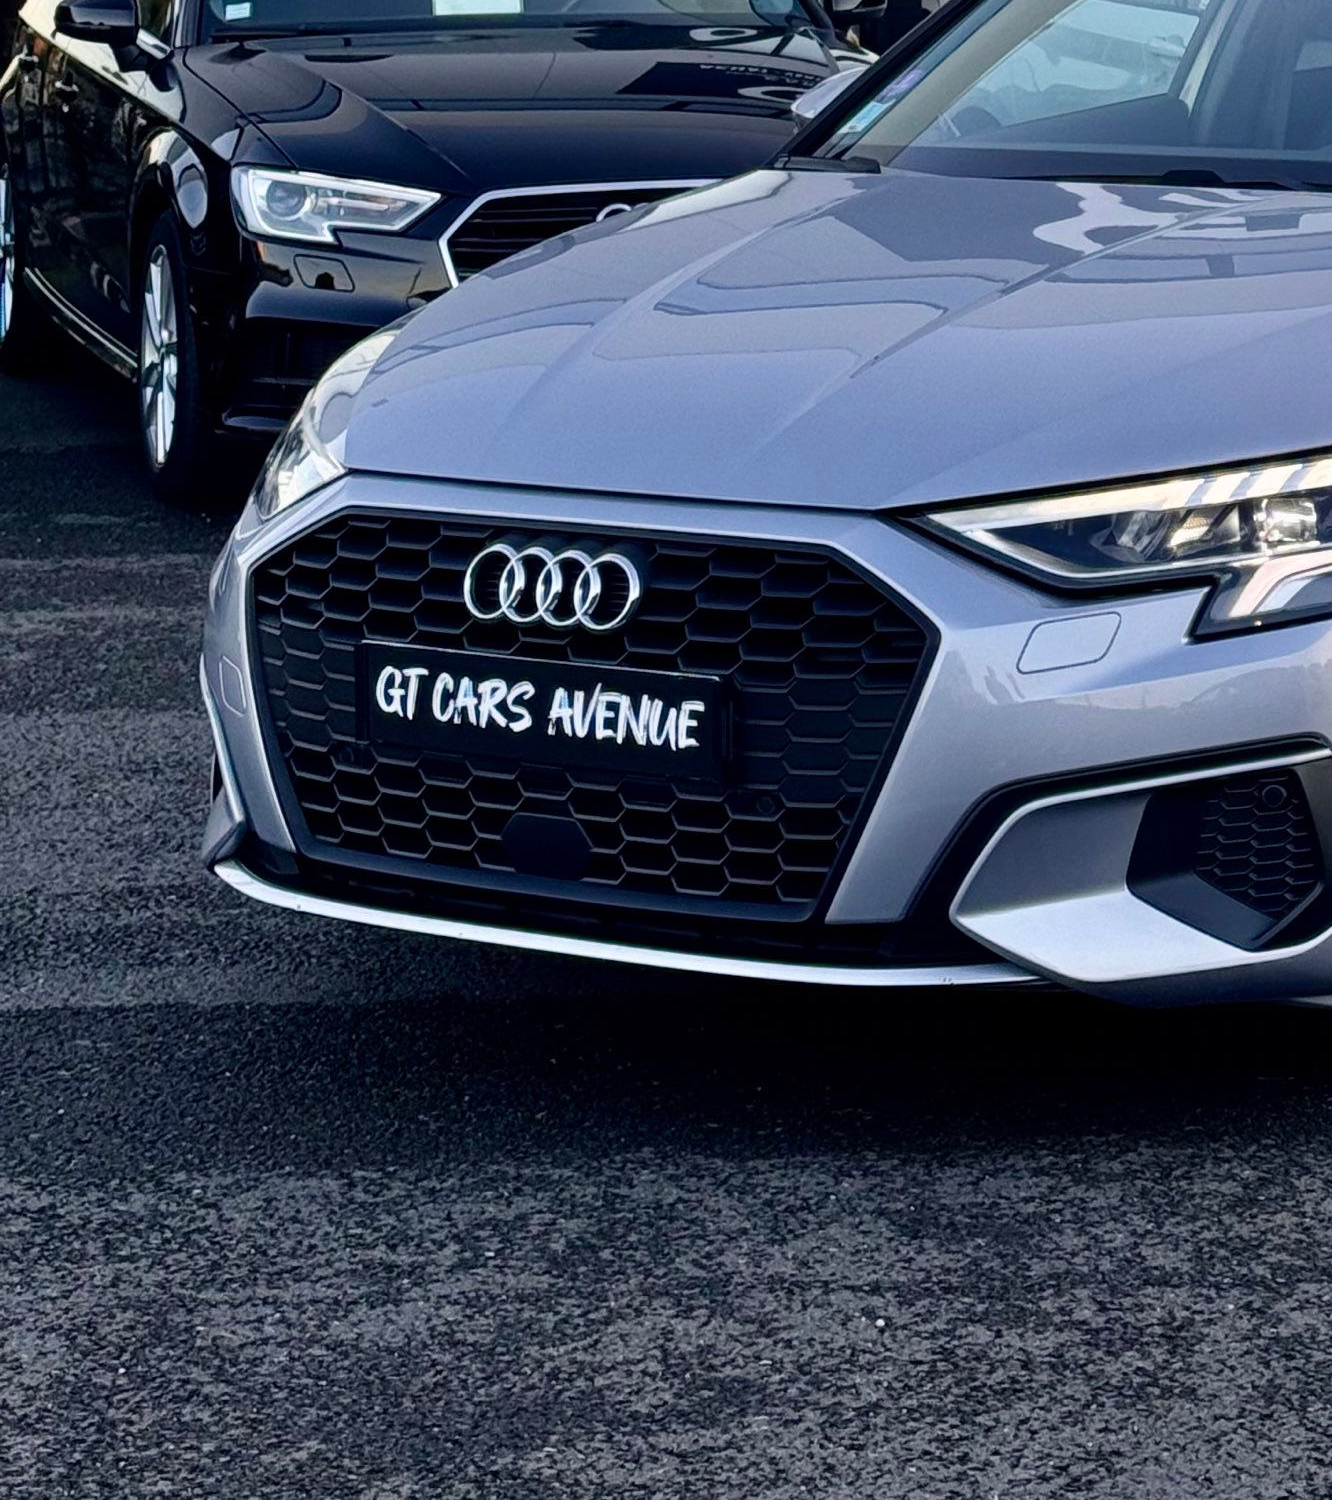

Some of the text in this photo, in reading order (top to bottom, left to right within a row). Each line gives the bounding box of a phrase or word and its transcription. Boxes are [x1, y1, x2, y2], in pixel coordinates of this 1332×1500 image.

[376, 666, 705, 752] GT CARS AVENUE
